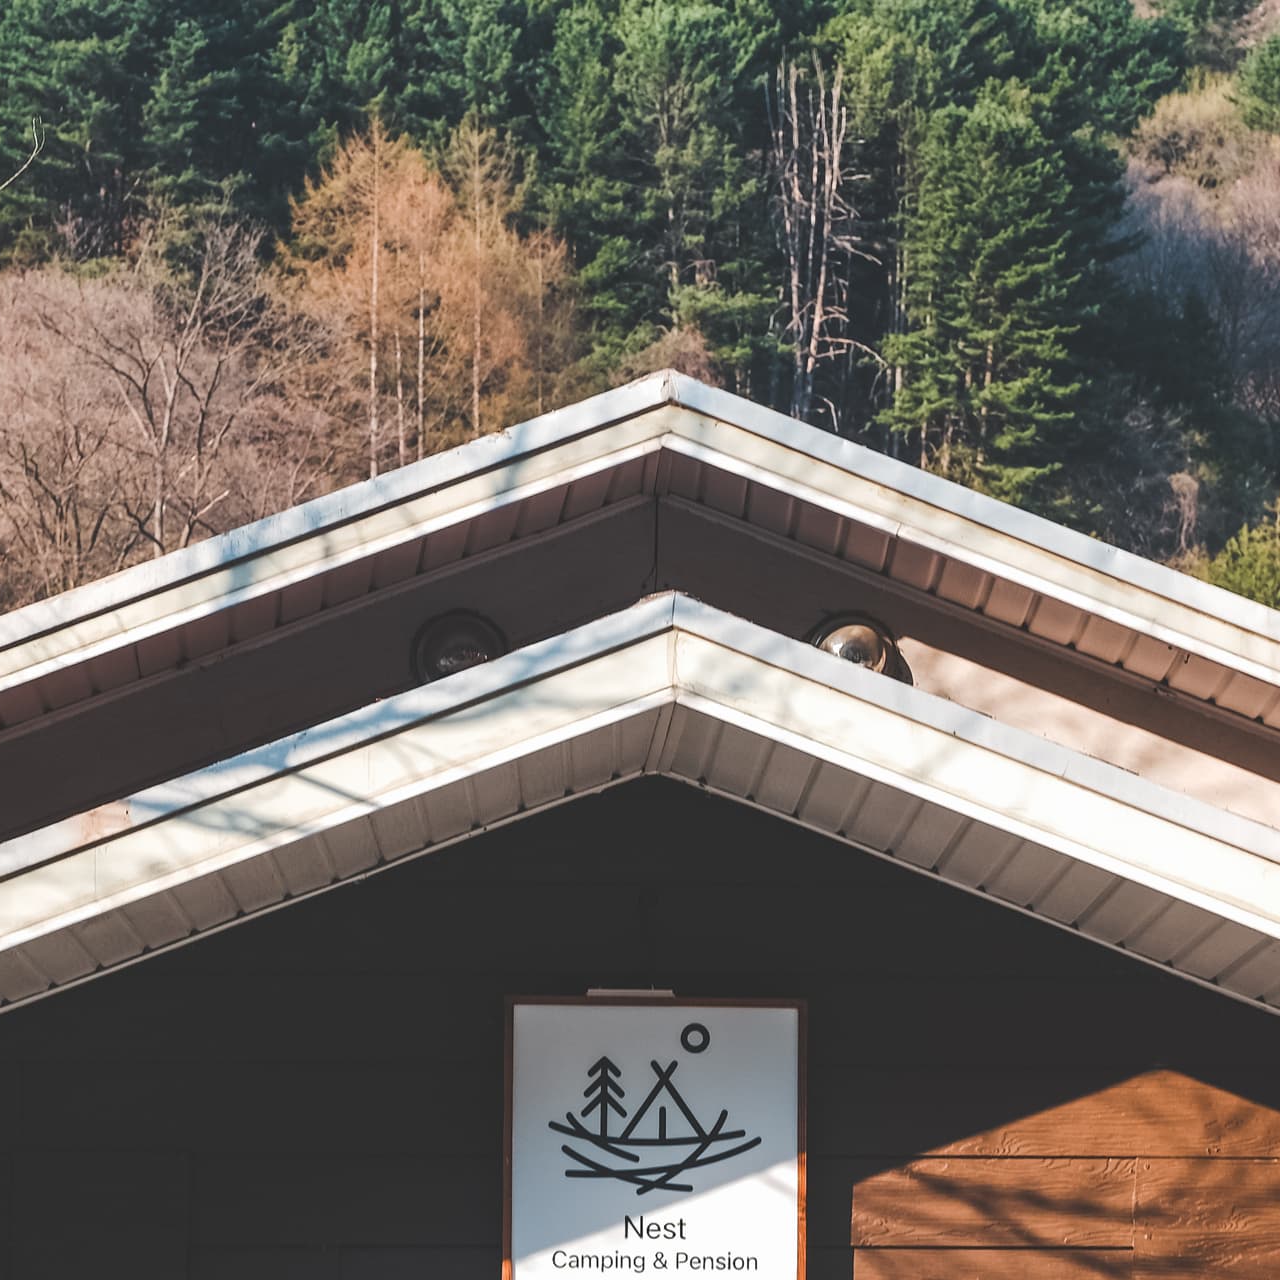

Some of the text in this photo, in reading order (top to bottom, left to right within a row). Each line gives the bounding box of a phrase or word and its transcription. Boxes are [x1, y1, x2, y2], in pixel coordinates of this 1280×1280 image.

[624, 1215, 686, 1240] Nest
[552, 1250, 758, 1273] Camping & Pension
